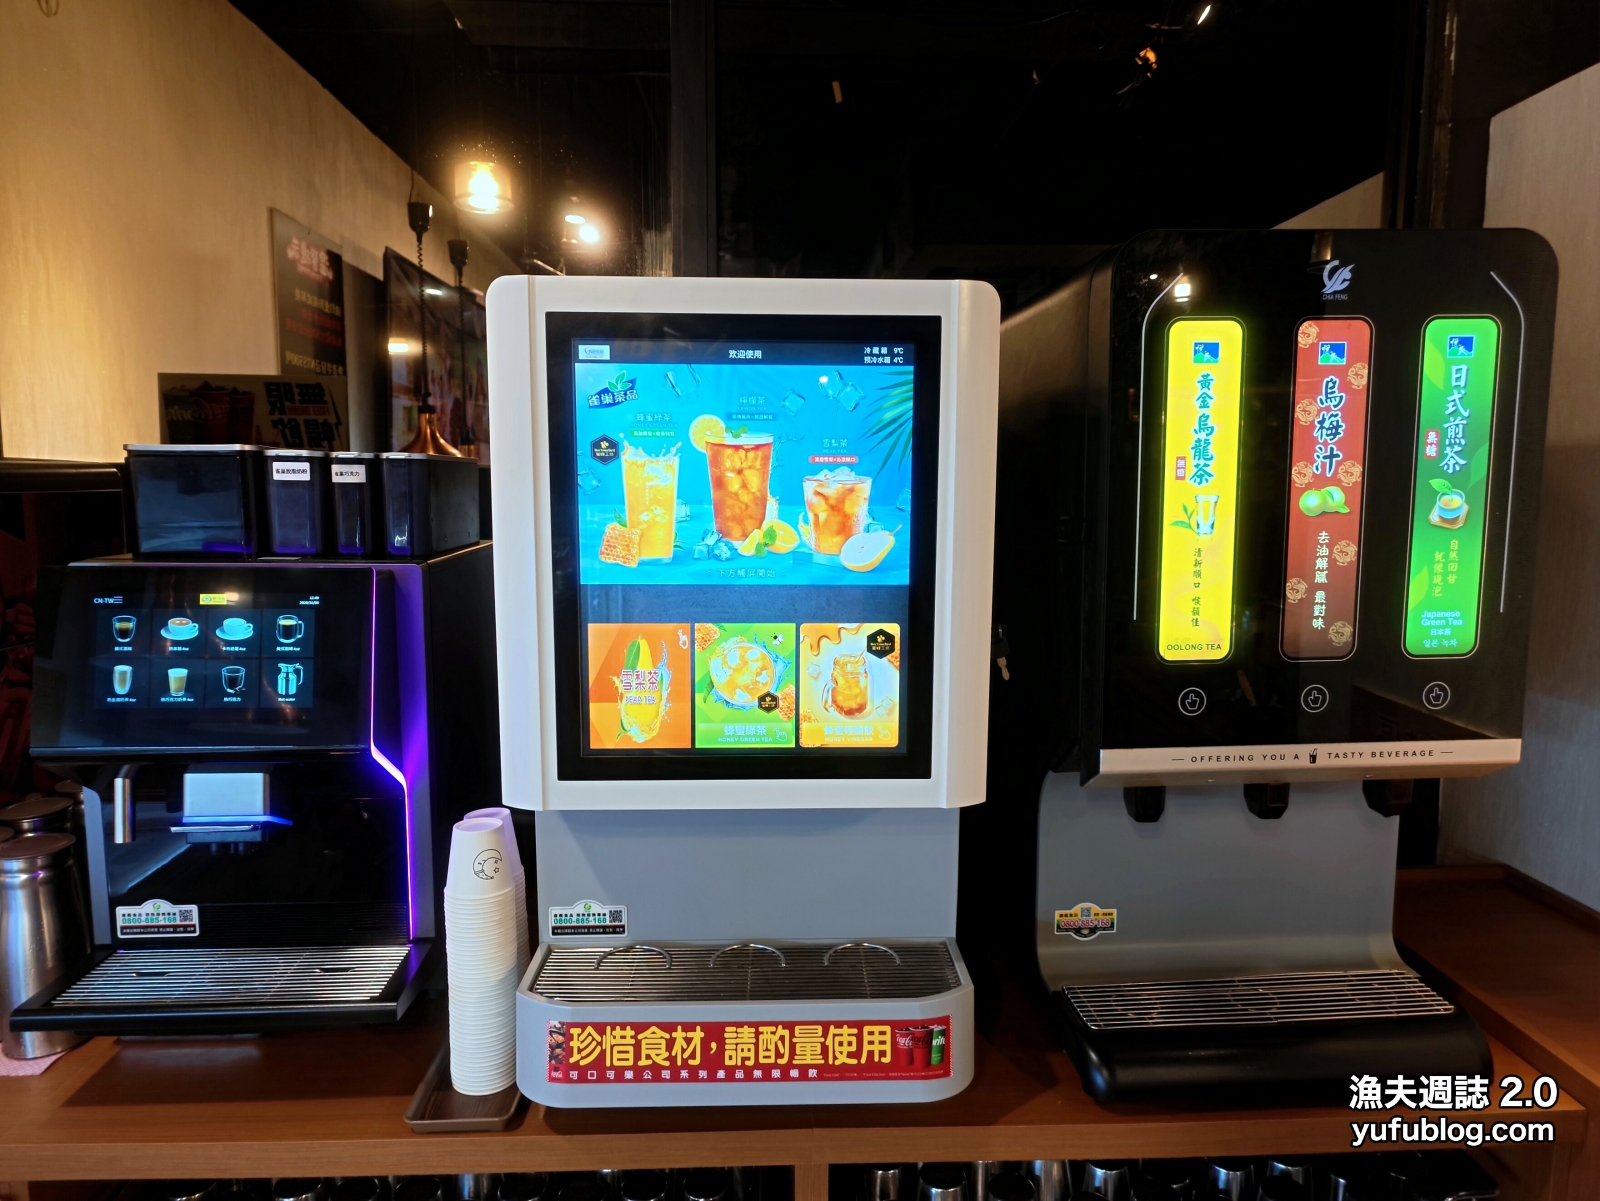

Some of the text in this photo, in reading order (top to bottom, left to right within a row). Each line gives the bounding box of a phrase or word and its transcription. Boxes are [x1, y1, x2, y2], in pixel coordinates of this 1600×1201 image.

[728, 349, 762, 359] 欢迎使用
[588, 389, 639, 407] 雀巢茶品
[1439, 363, 1470, 474] 日式煎茶
[1189, 372, 1215, 486] 黃金烏龍茶
[1313, 376, 1345, 477] 烏梅汁
[1425, 430, 1438, 457] 無糖
[1192, 547, 1203, 588] 清新順口
[1447, 539, 1459, 584] 自然回甘
[1312, 530, 1331, 630] 去油解膩 最對味
[1432, 551, 1446, 597] 就像現泡
[1421, 610, 1461, 619] Japanese
[1421, 618, 1463, 626] Green Tea
[1430, 628, 1452, 636] 日本茶
[1166, 643, 1203, 651] OOLONG
[1423, 639, 1439, 648] 일본
[621, 669, 659, 693] 雪梨茶
[625, 695, 657, 704] PEAR TEA
[1190, 754, 1254, 763] OFFERING
[1327, 751, 1364, 759] TASTY
[1371, 750, 1435, 758] BEVERAGE
[121, 916, 177, 925] 0800-885-168
[553, 917, 607, 925] 0800-885-168
